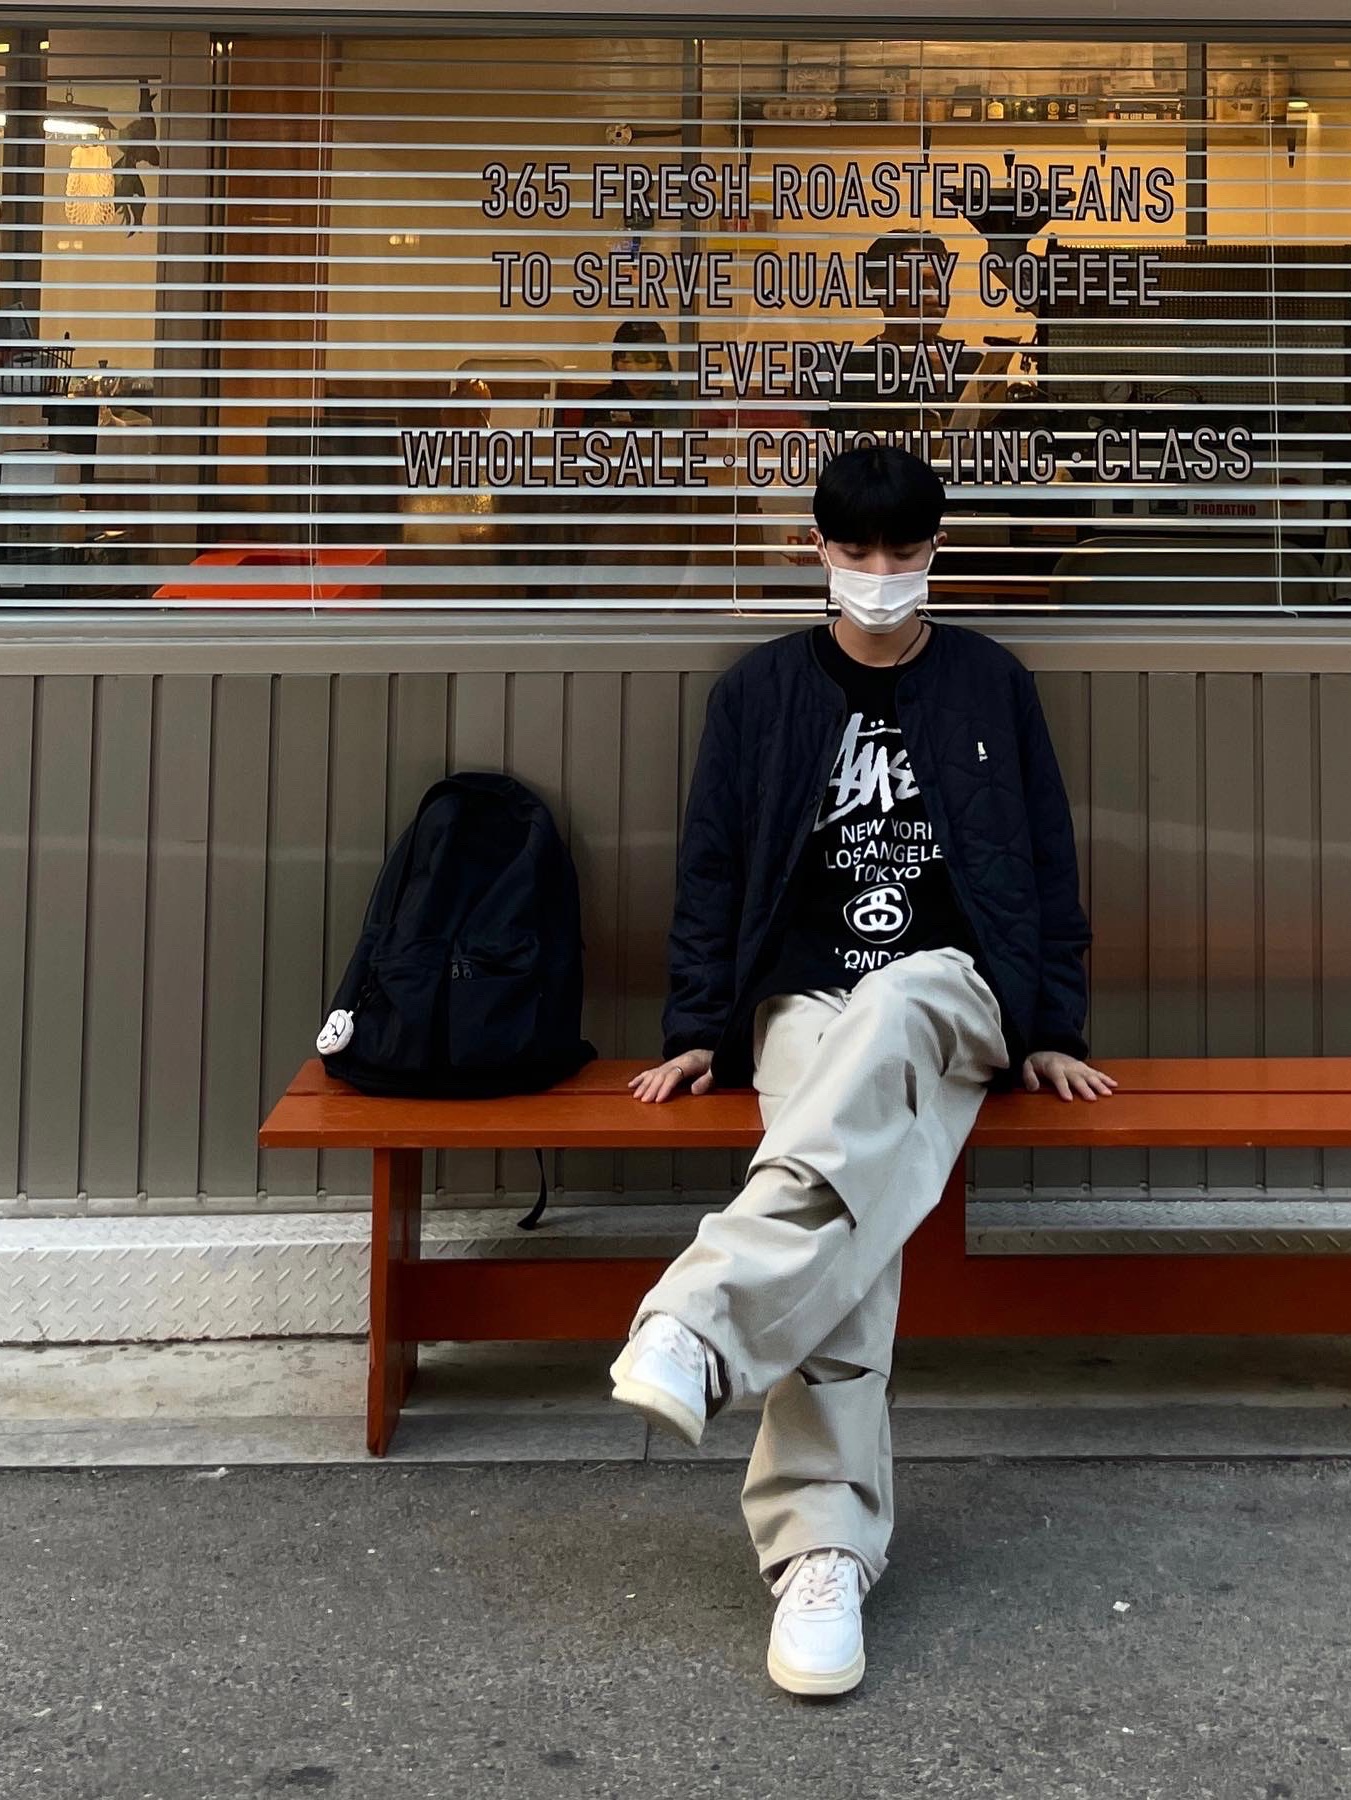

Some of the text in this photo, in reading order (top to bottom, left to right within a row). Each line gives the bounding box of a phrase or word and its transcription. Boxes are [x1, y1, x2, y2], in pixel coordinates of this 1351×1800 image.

[482, 161, 1175, 223] 365 FRESH ROASTED BEANS
[492, 251, 1161, 310] TO SERVE QUALITY COFFEE
[698, 340, 965, 398] EVERY DAY
[401, 430, 708, 488] WHOLESALE
[1096, 427, 1254, 482] CLASS
[841, 818, 886, 844] NEW
[863, 840, 944, 863] ANGELE
[854, 863, 921, 882] TOKYO
